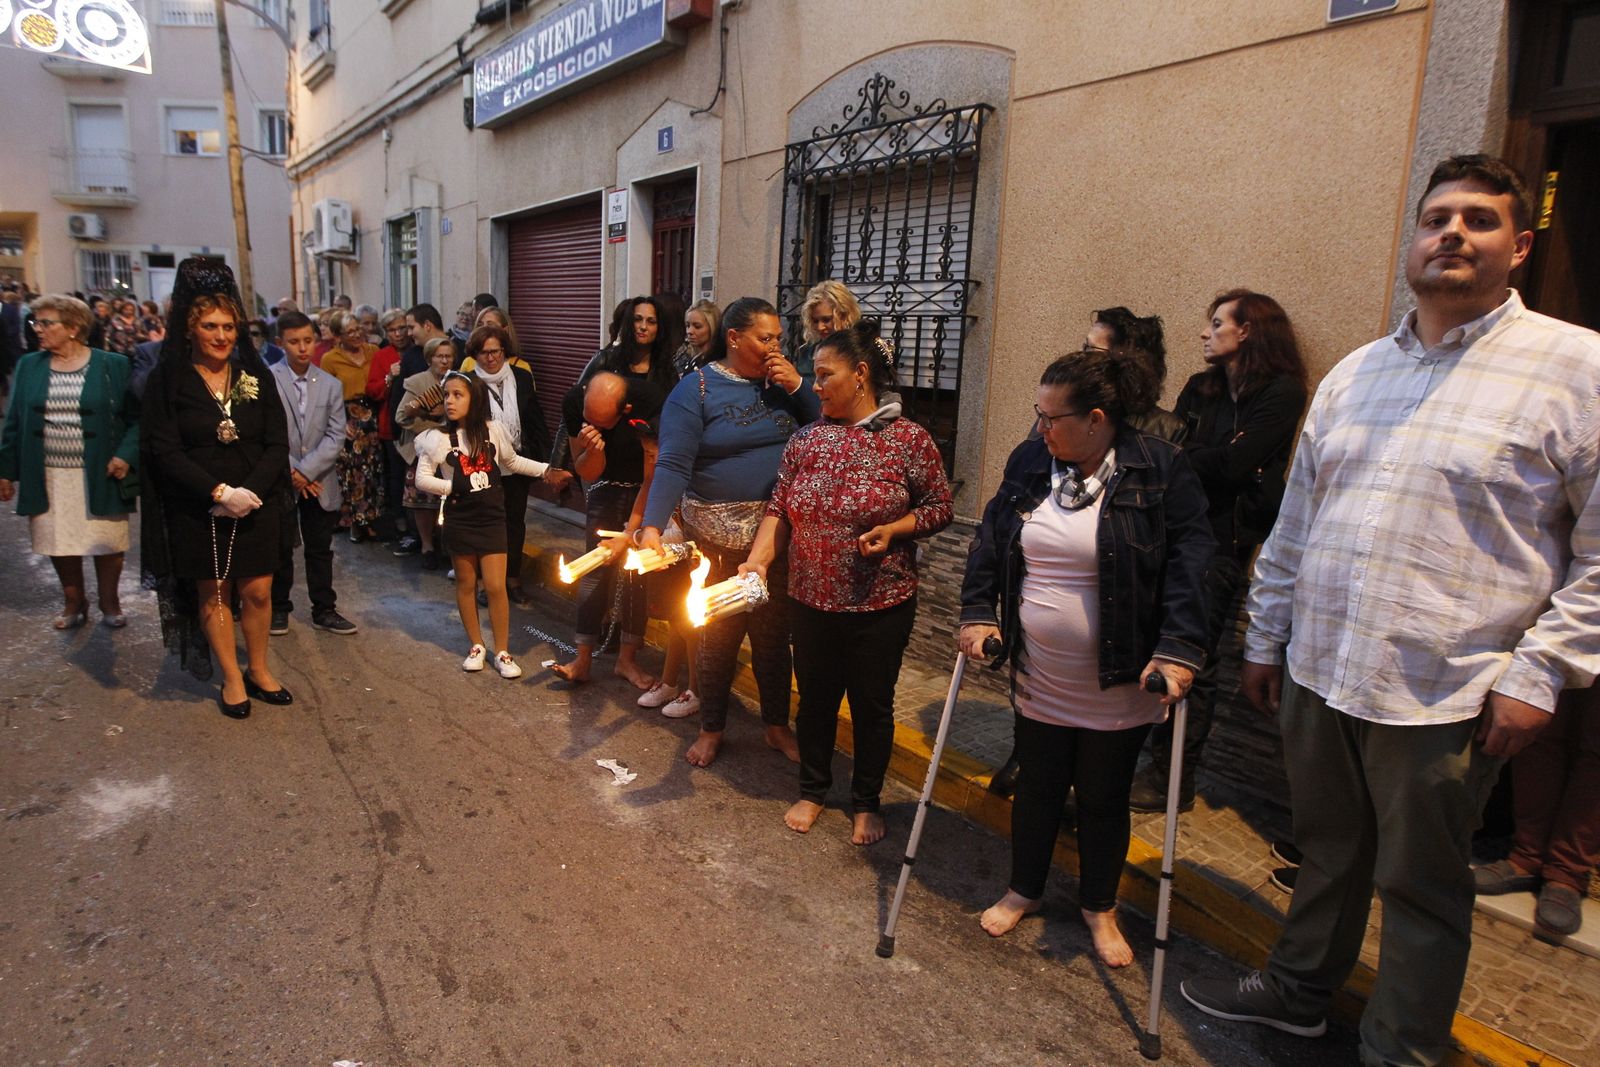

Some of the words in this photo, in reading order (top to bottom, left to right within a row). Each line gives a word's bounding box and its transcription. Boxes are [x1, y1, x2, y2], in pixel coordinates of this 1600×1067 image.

[476, 37, 536, 96] GALERIAS
[538, 1, 597, 63] TIENDA
[503, 38, 613, 107] EXPOSICION
[663, 131, 669, 148] 6
